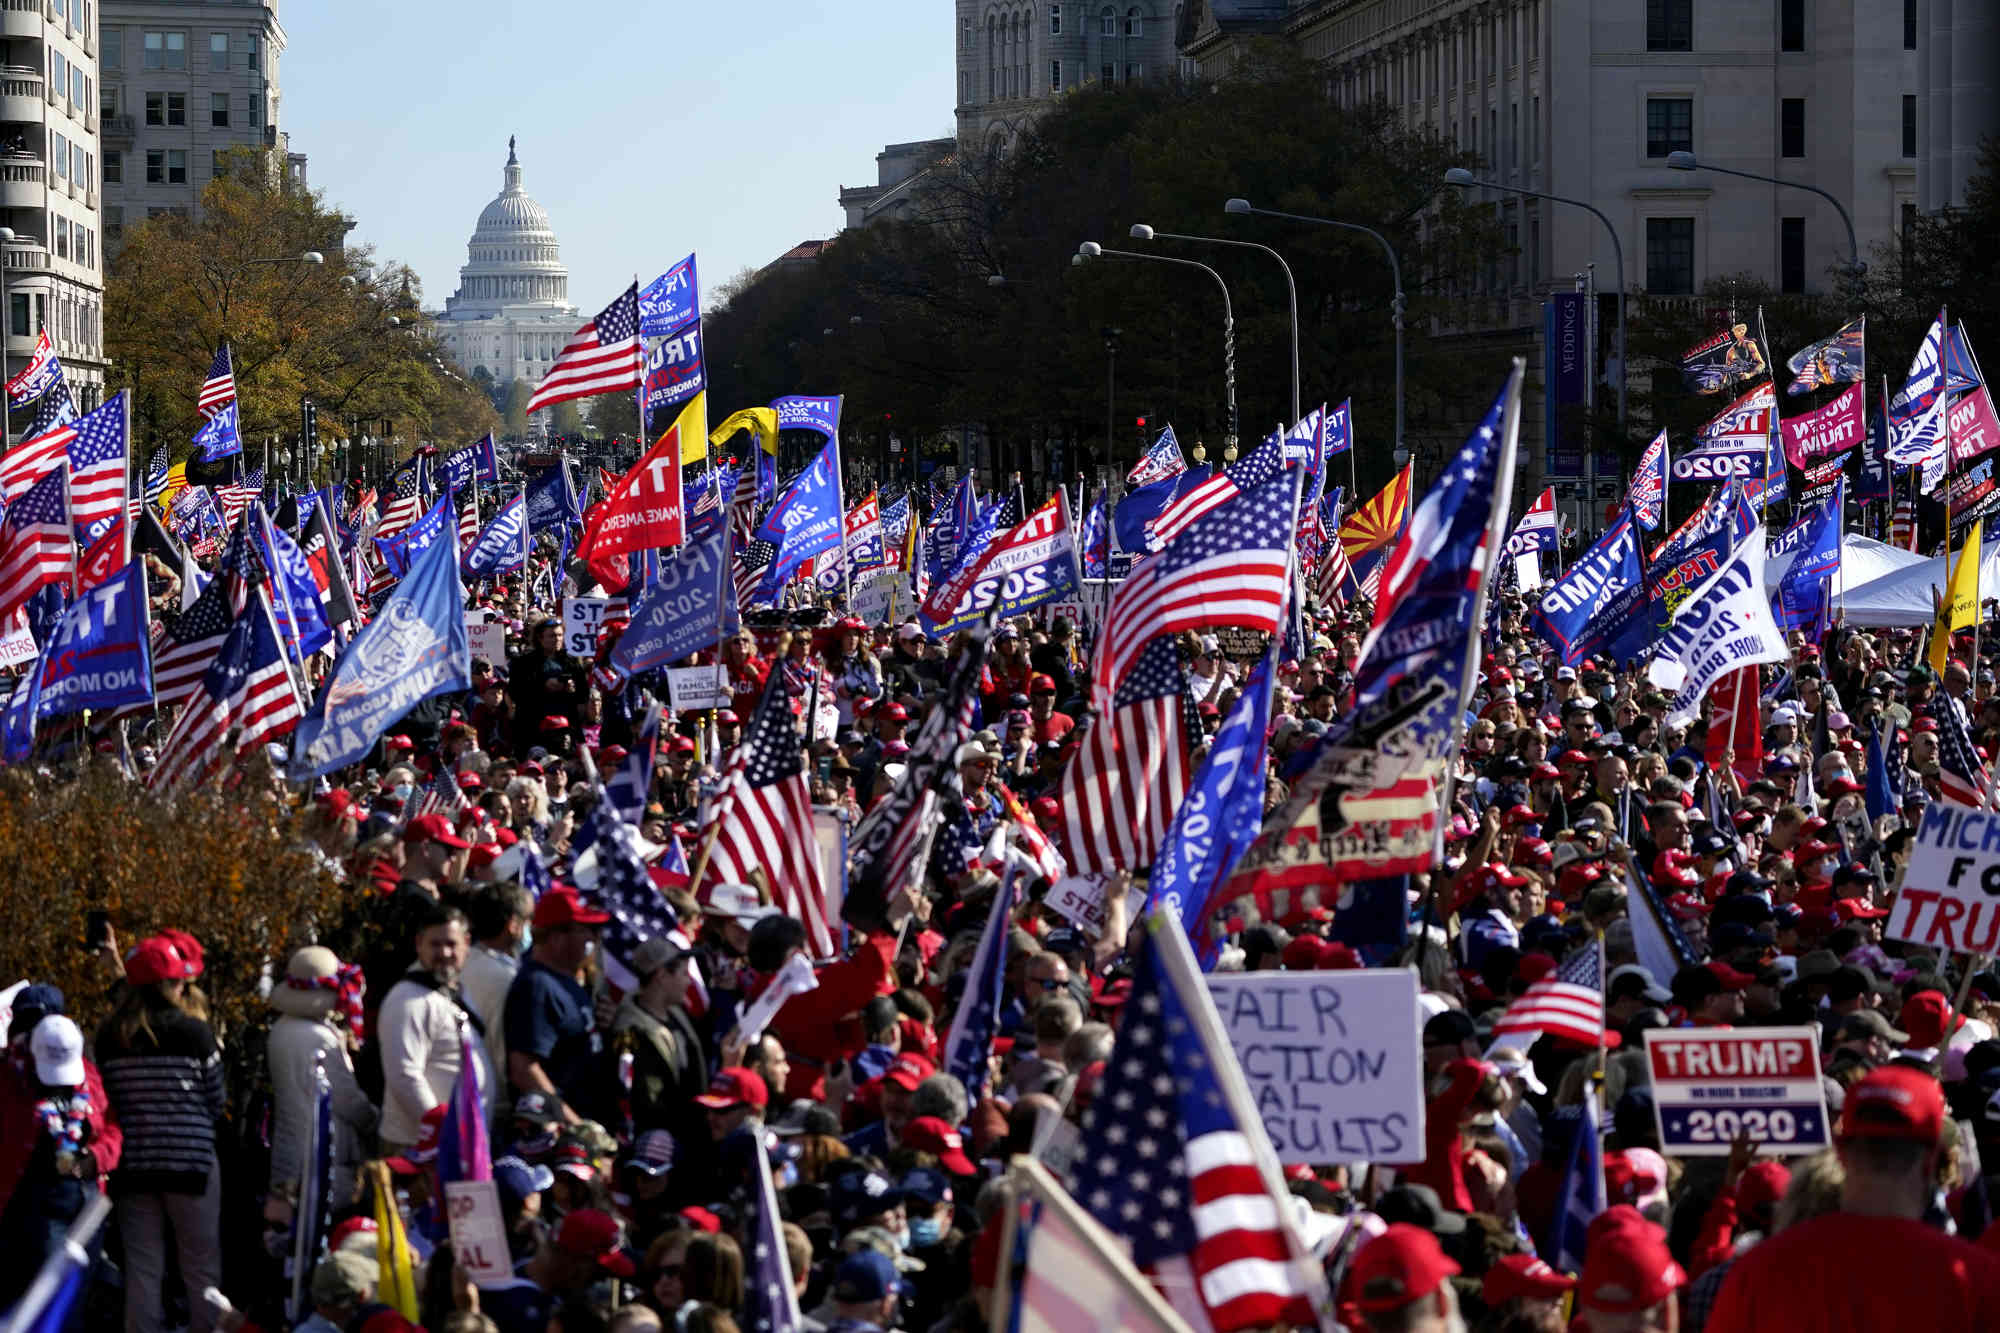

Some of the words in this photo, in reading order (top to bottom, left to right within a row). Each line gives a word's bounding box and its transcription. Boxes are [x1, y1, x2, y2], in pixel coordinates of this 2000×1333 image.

[1562, 299, 1576, 374] WEDDINGS
[1062, 890, 1100, 922] STE
[1243, 1045, 1387, 1086] CTION
[1658, 1041, 1804, 1076] TRUMP
[1687, 1110, 1796, 1142] 2020
